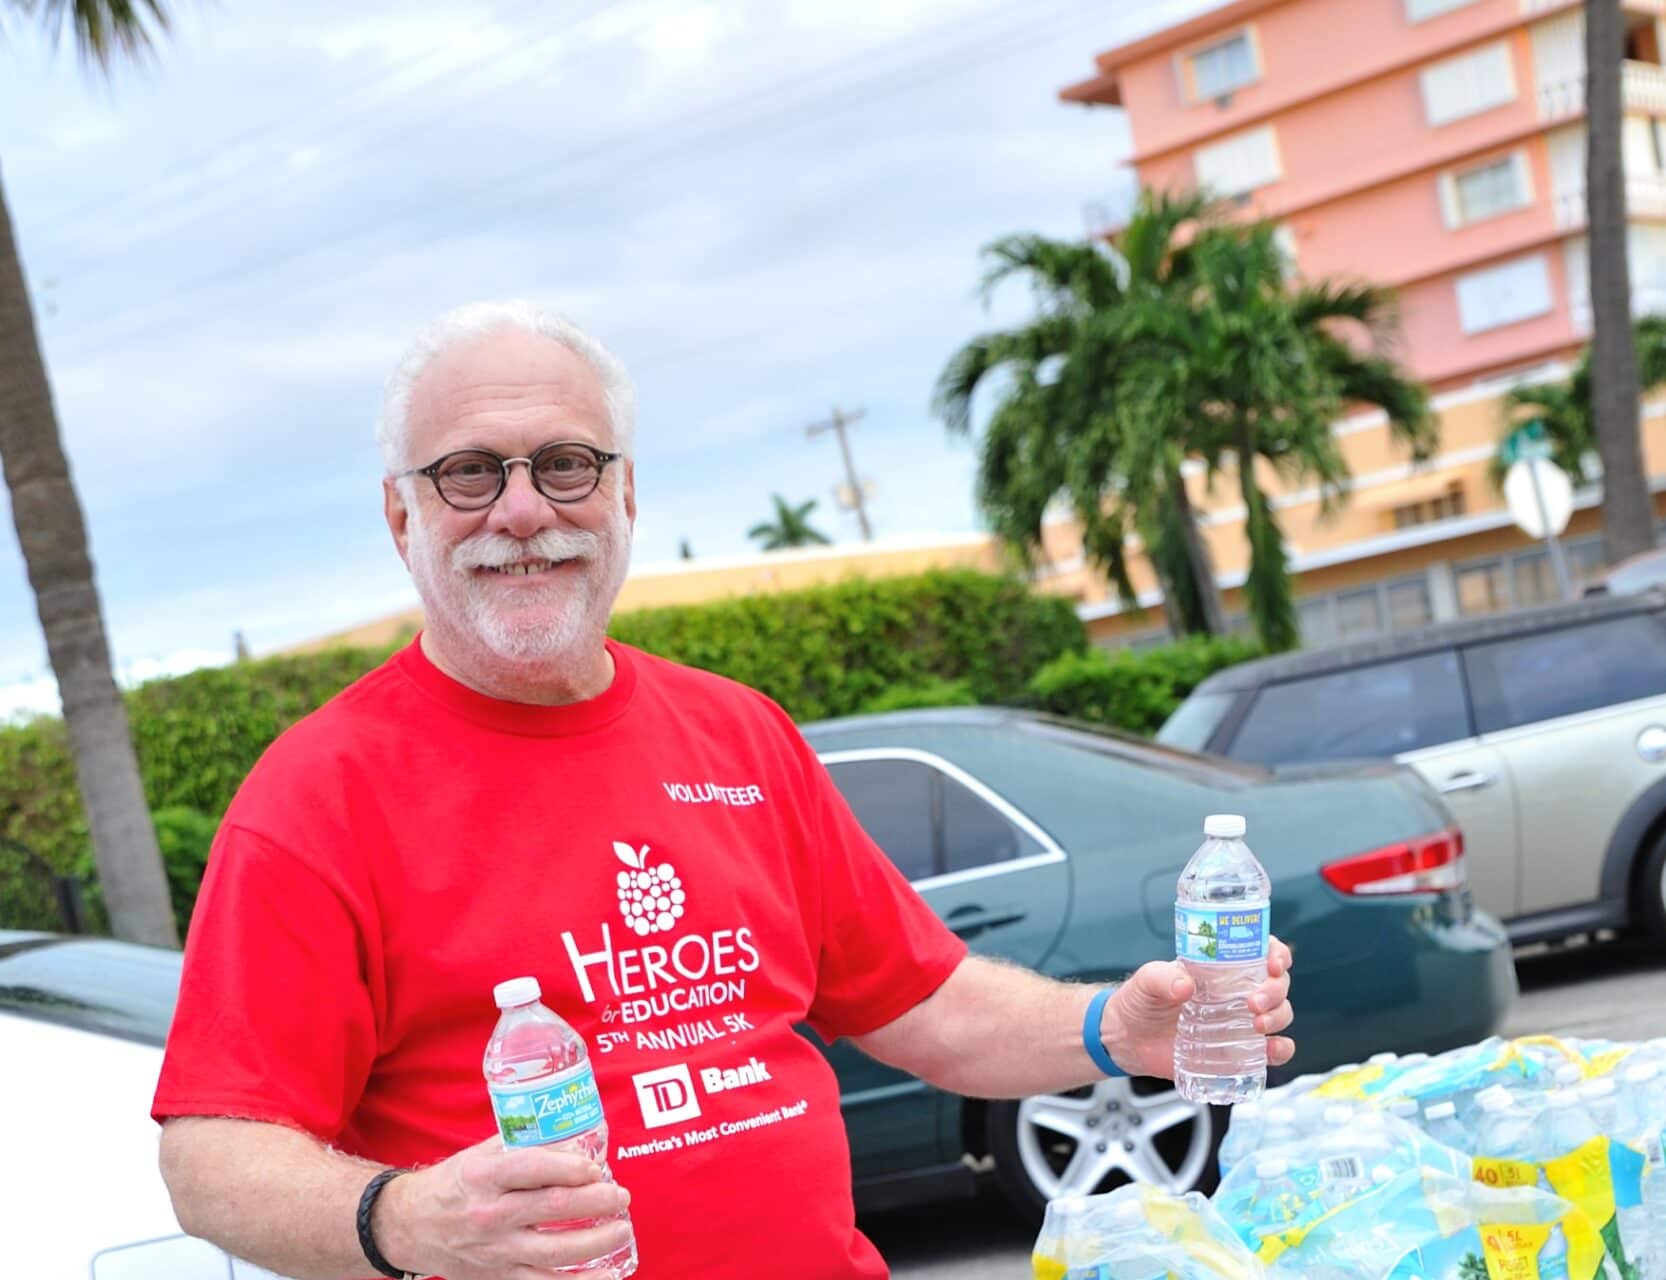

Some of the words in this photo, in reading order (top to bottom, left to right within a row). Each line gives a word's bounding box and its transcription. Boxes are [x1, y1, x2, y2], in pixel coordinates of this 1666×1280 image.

[662, 782, 764, 807] VOLUNTEER
[561, 922, 761, 1004] HEROES
[620, 978, 746, 1025] EDUCATION
[596, 1030, 631, 1054] 5TH
[636, 1018, 727, 1051] ANNUAL
[722, 1012, 756, 1034] 5K
[642, 1078, 688, 1113] TD
[699, 1056, 773, 1095] Bank
[616, 1134, 684, 1161] America's
[683, 1126, 720, 1147] Most
[719, 1109, 783, 1137] Convenient
